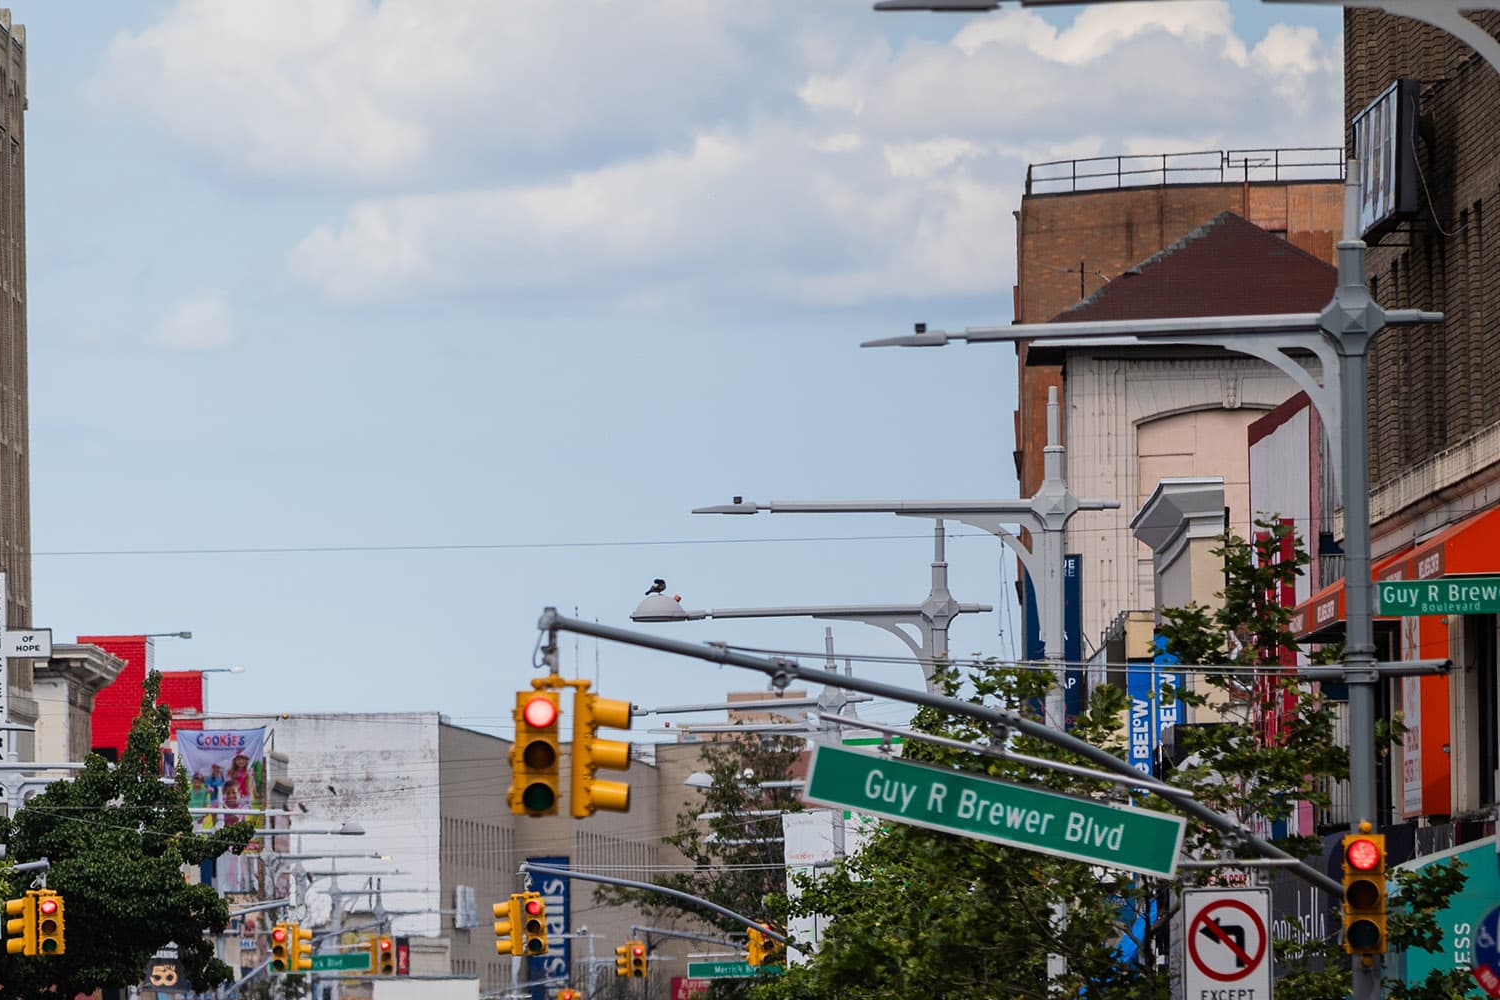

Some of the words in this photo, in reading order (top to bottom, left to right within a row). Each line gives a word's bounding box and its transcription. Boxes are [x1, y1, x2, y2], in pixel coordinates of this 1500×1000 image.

[1383, 586, 1419, 607] Guy
[1428, 585, 1439, 601] R
[1449, 584, 1500, 601] Brew
[1421, 601, 1481, 612] Boulevard
[865, 769, 917, 813] Guy
[928, 783, 948, 812] R
[957, 789, 1054, 836] Brewer
[1065, 812, 1125, 851] Blvd
